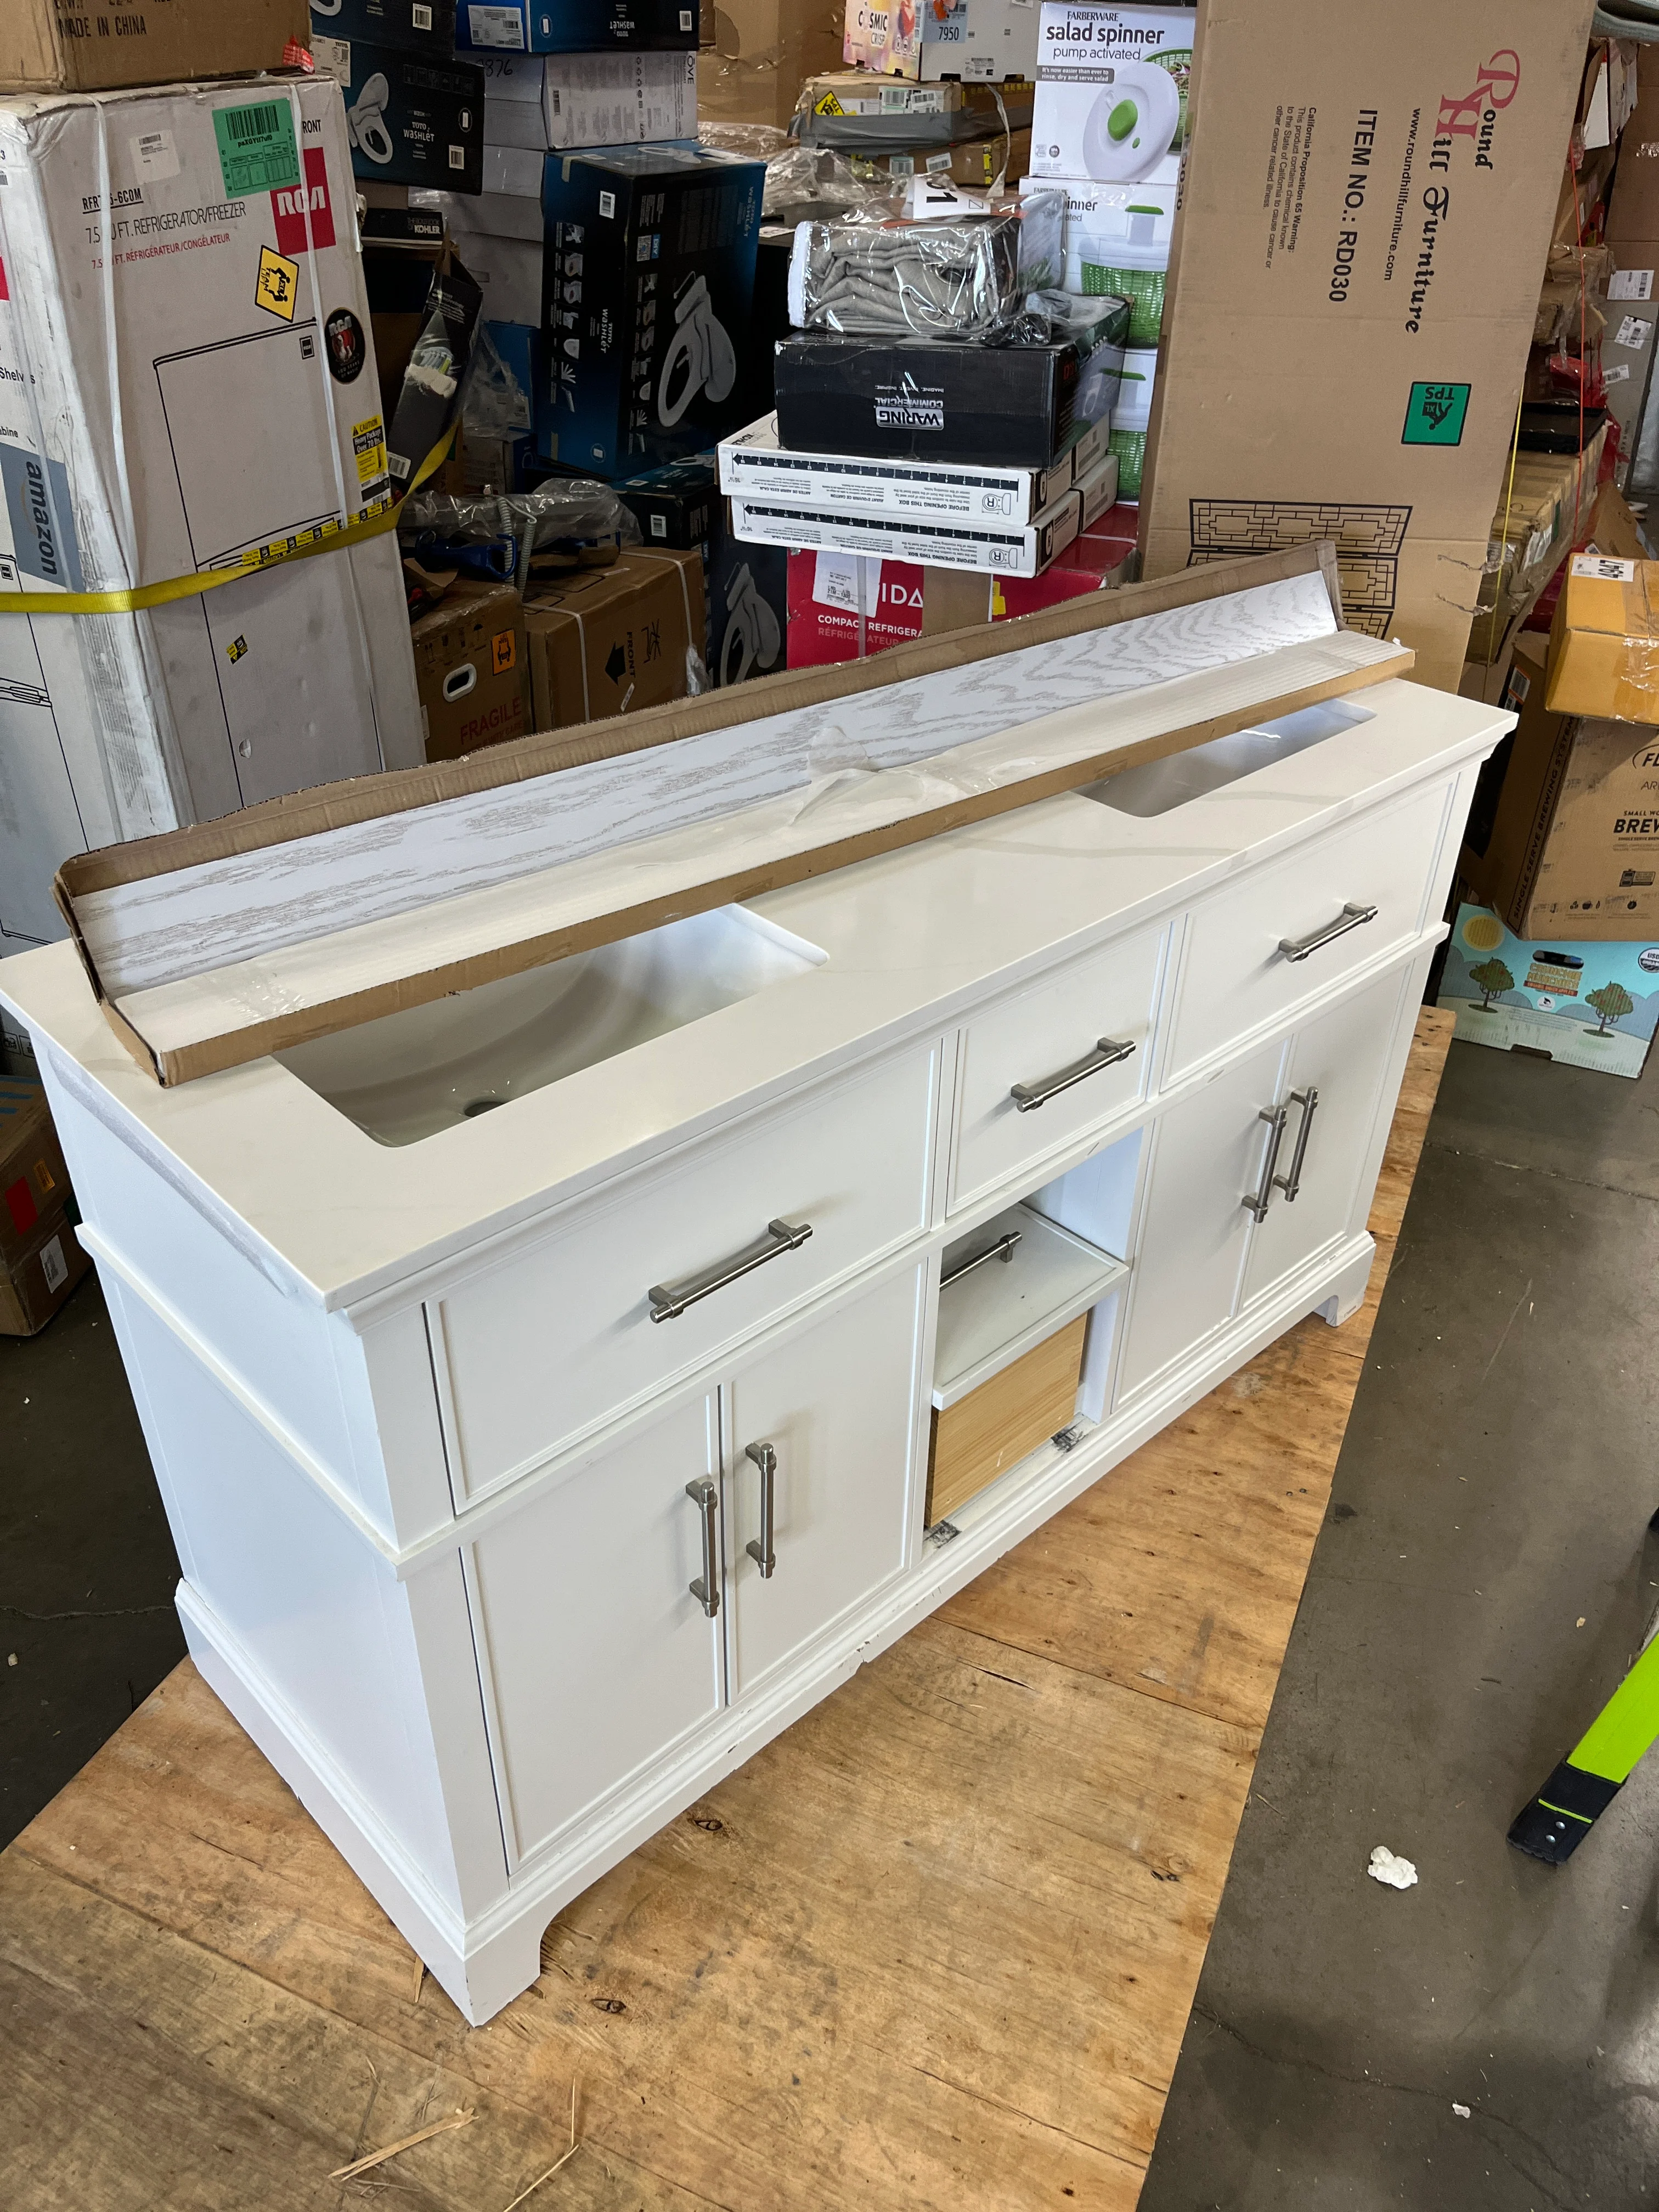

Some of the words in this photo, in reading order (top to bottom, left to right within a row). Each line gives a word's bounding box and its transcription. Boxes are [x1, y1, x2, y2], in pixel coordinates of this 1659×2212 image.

[58, 16, 91, 38] MADE
[97, 16, 110, 36] IN
[115, 15, 147, 36] CHINA
[1067, 11, 1119, 21] FARBERWARE
[938, 27, 959, 41] 7950
[1046, 21, 1093, 41] salad
[1097, 23, 1165, 46] spinner
[1053, 48, 1087, 60] pump
[1090, 47, 1141, 60] activated
[302, 119, 321, 133] RONT
[412, 121, 427, 130] TOTO
[1297, 107, 1306, 123] This
[1292, 126, 1301, 154] product
[1304, 107, 1317, 149] California
[1351, 110, 1378, 166] ITEM
[1270, 128, 1279, 154] cancer
[1282, 130, 1291, 151] State
[1267, 155, 1276, 182] related
[1282, 152, 1288, 161] of
[1276, 162, 1287, 198] California
[1287, 156, 1297, 188] contains
[1296, 151, 1310, 201] Proposition
[83, 188, 142, 210] RFR-6COM
[276, 187, 325, 216] RCA
[1066, 196, 1097, 212] inner
[1283, 190, 1293, 223] chemical
[1342, 174, 1368, 222] NO.:
[1384, 108, 1420, 281] www.roundhillfurniture.com
[1295, 204, 1303, 213] 65
[86, 227, 100, 244] 7.5
[134, 201, 246, 235] REFRIGERATOR/FREEZER
[414, 225, 441, 234] KOHLER
[1288, 215, 1301, 253] Warning:
[1279, 225, 1289, 250] known
[1329, 230, 1357, 302] RD030
[1406, 187, 1449, 334] Furniture
[329, 316, 352, 337] RCA
[0, 367, 35, 385] Shelvs
[874, 397, 943, 409] COMMERCIAL
[1424, 386, 1455, 400] TPS
[360, 417, 378, 432] CAUTION
[879, 408, 941, 426] WARING
[988, 498, 995, 507] R
[26, 461, 57, 575] amazon
[994, 552, 1001, 561] R
[818, 615, 859, 628] COMPAC
[626, 631, 636, 678] FRONT
[461, 695, 522, 746] FRAGILE
[1514, 876, 1529, 919] SINGLE
[1527, 834, 1540, 873] SERVE
[1538, 770, 1558, 831] BREWING
